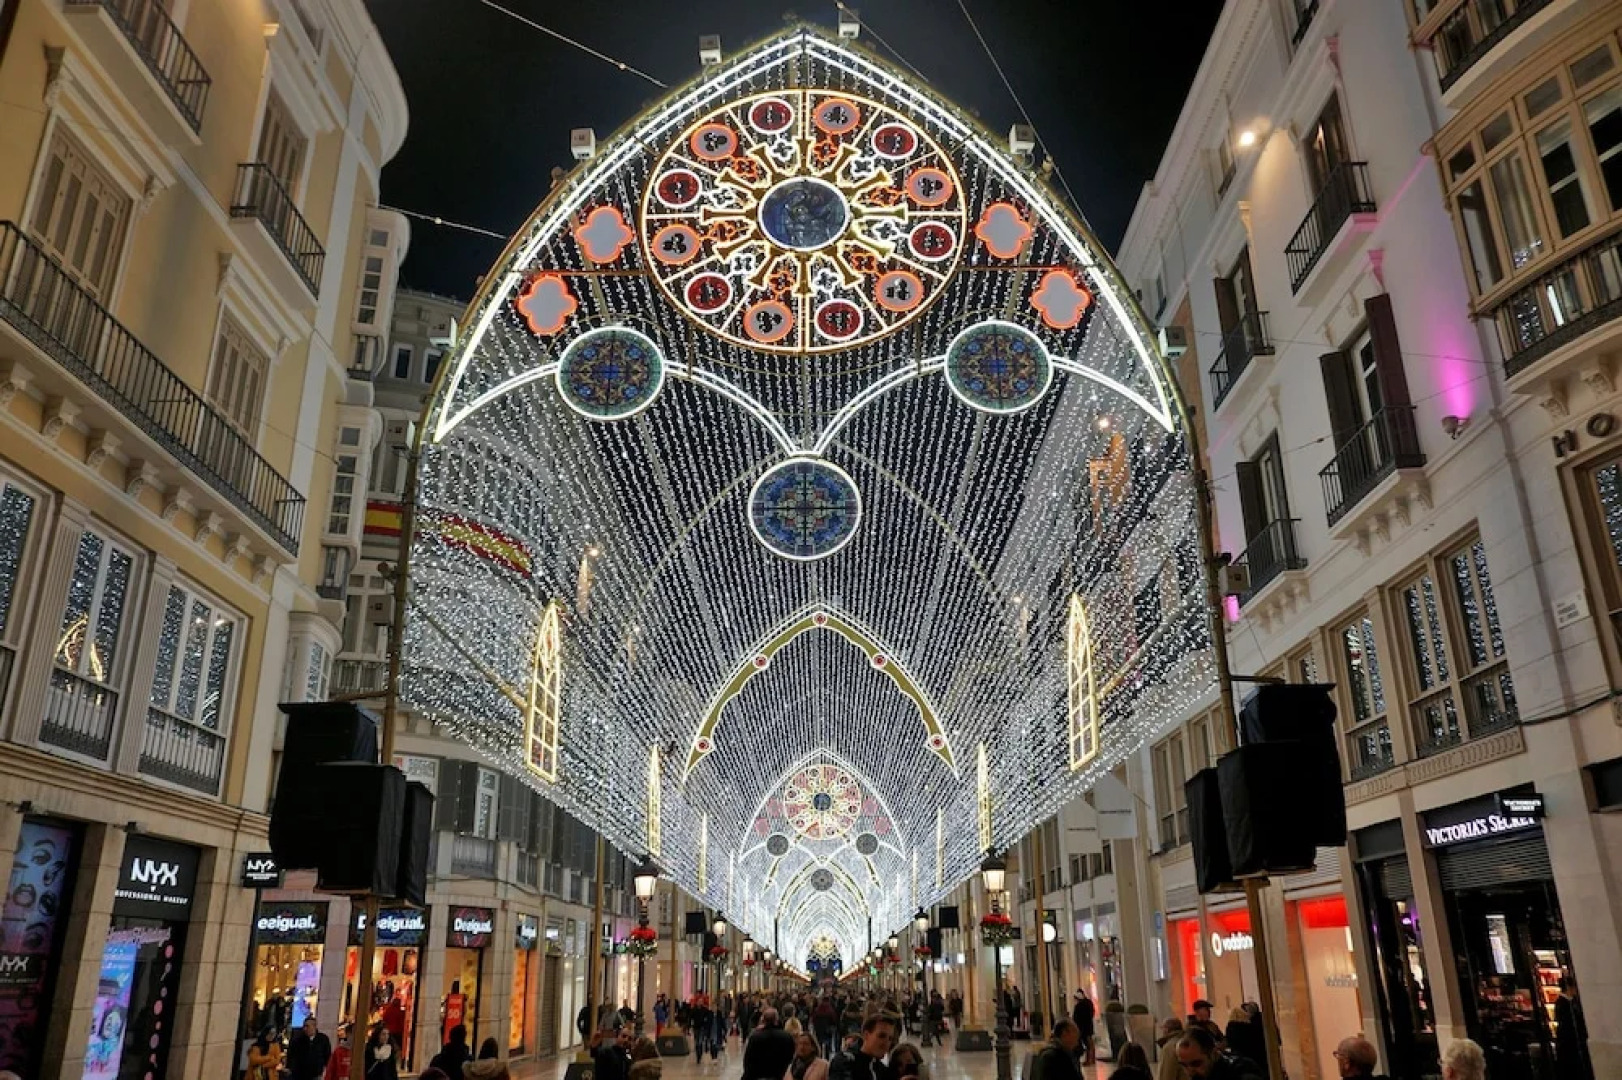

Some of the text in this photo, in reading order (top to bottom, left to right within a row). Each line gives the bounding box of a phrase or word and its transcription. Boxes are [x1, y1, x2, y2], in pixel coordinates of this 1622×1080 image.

[1426, 819, 1488, 844] VICTORIA'S
[131, 857, 179, 892] NYX
[257, 915, 316, 932] esigual.
[1222, 931, 1253, 951] vodafon
